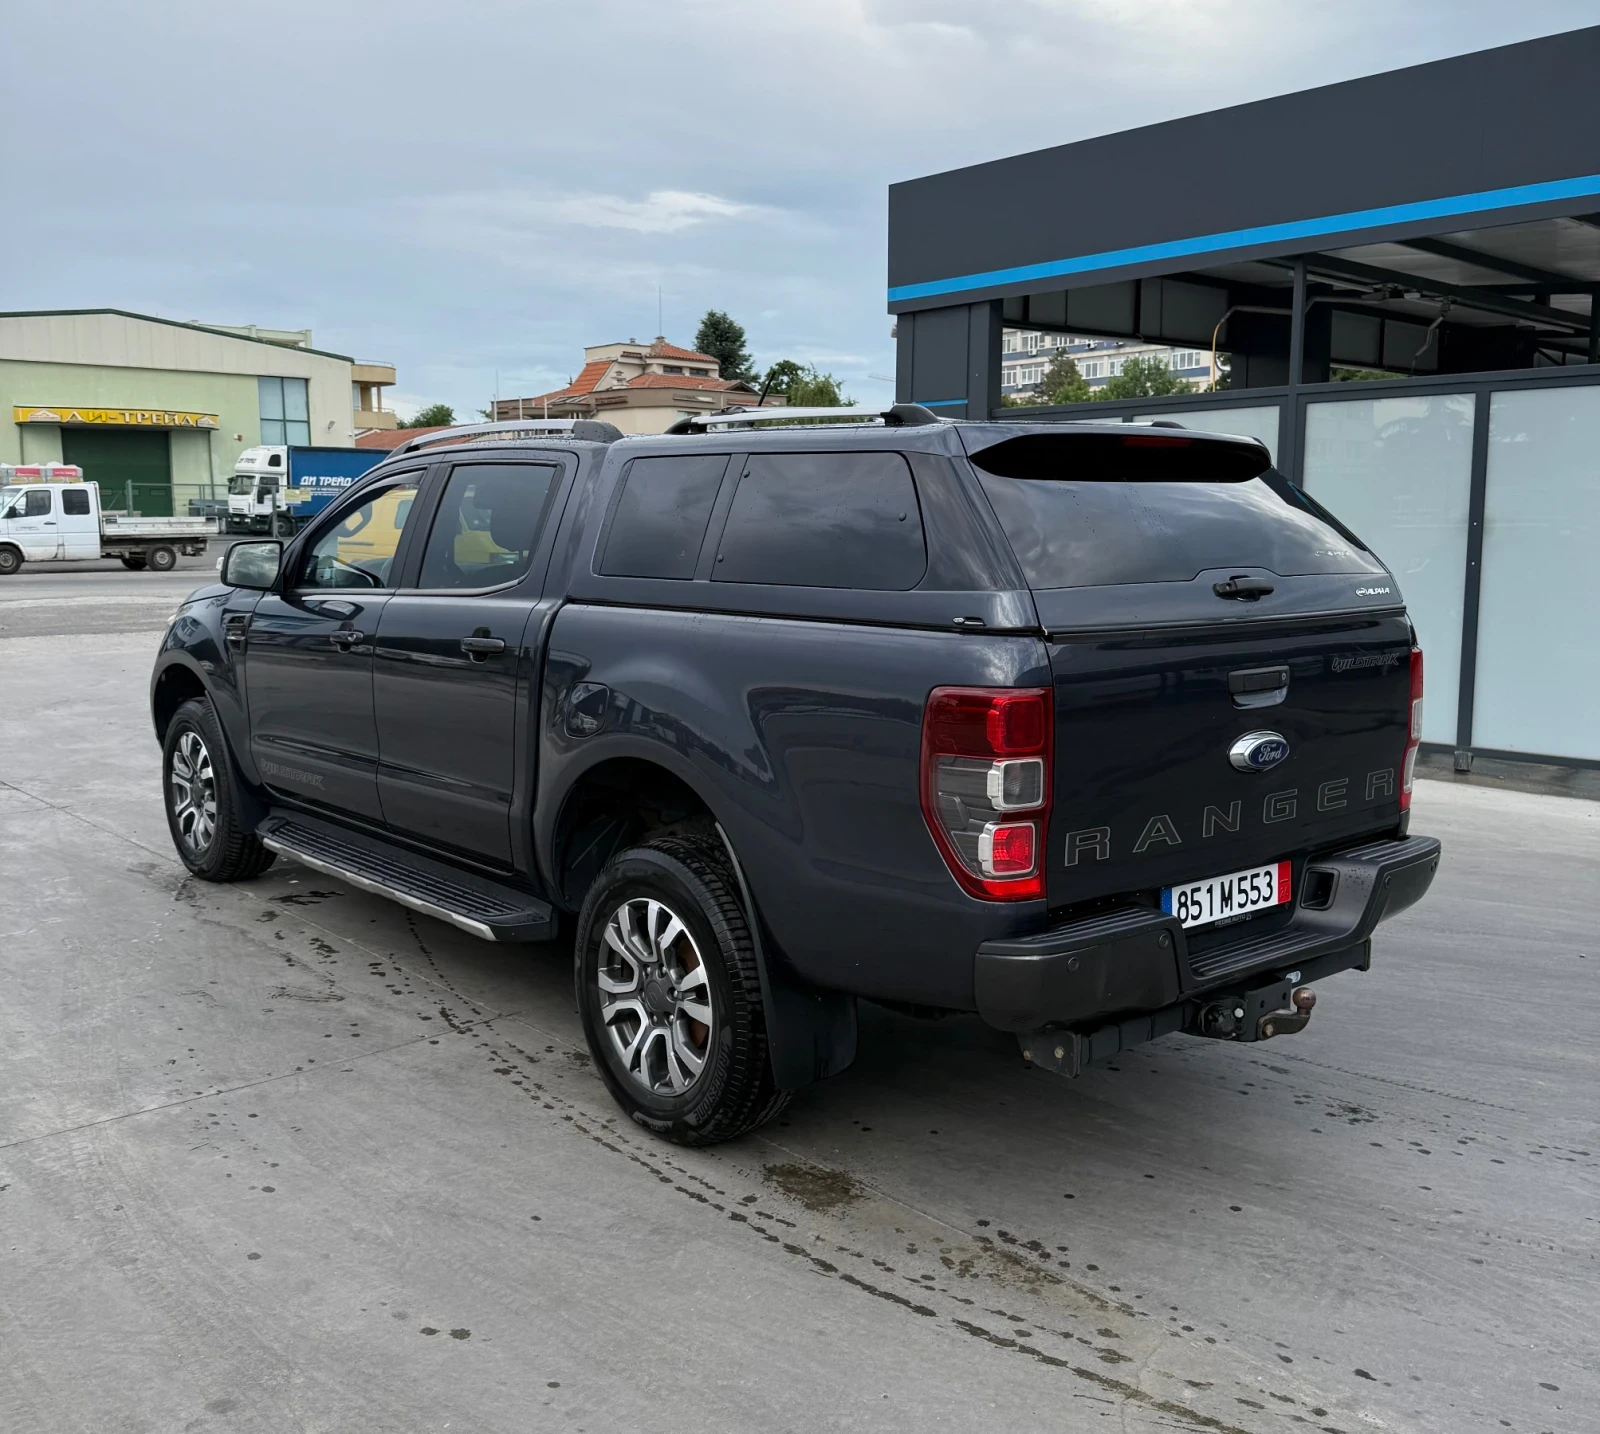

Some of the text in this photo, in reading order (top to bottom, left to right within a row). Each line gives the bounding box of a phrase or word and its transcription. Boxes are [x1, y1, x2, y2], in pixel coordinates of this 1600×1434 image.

[300, 475, 352, 487] ДИ ТРЕЙД
[1332, 653, 1399, 673] WILDTRAK
[1258, 743, 1283, 763] Ford
[1064, 768, 1395, 867] RANGER
